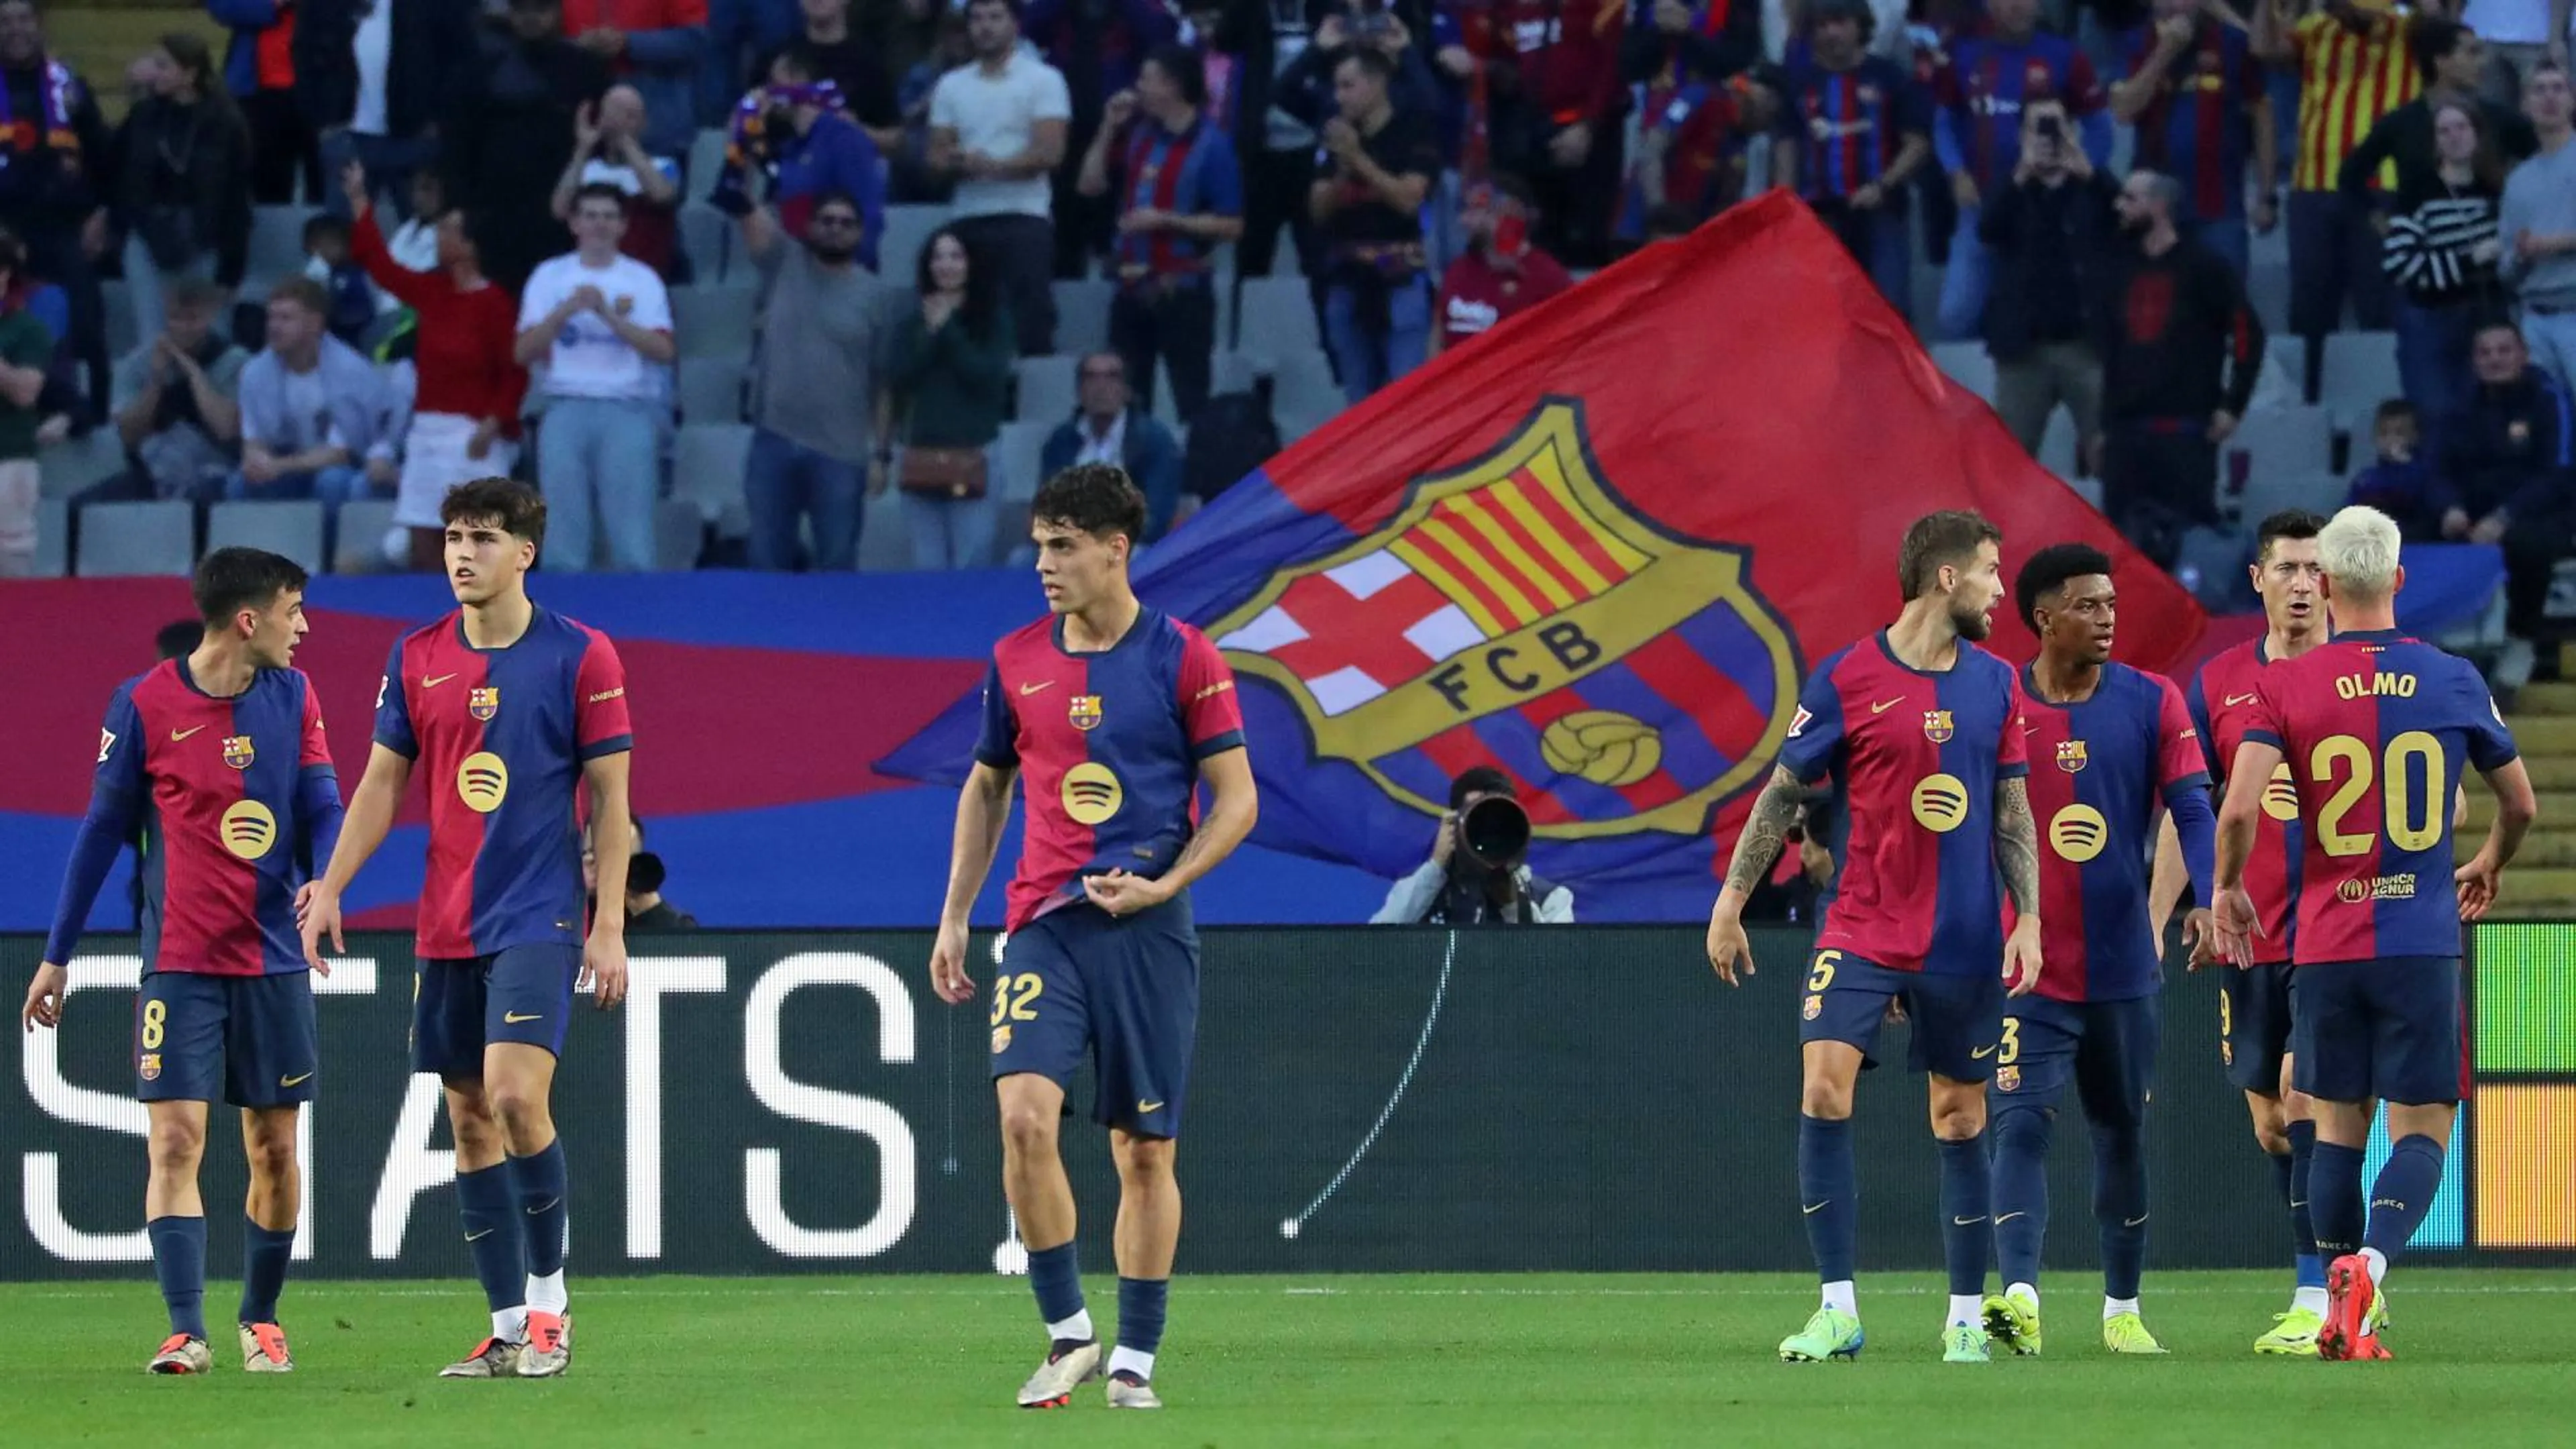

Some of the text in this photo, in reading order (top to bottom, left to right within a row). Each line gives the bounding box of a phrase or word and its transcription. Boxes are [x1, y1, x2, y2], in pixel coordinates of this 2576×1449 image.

[2336, 672, 2416, 700] OLMO
[2311, 731, 2445, 857] 20
[2371, 873, 2415, 887] UNHCR
[1809, 950, 1842, 991] 5
[991, 972, 1042, 1026] 32
[142, 1000, 166, 1049] 8
[1998, 1017, 2019, 1063] 3
